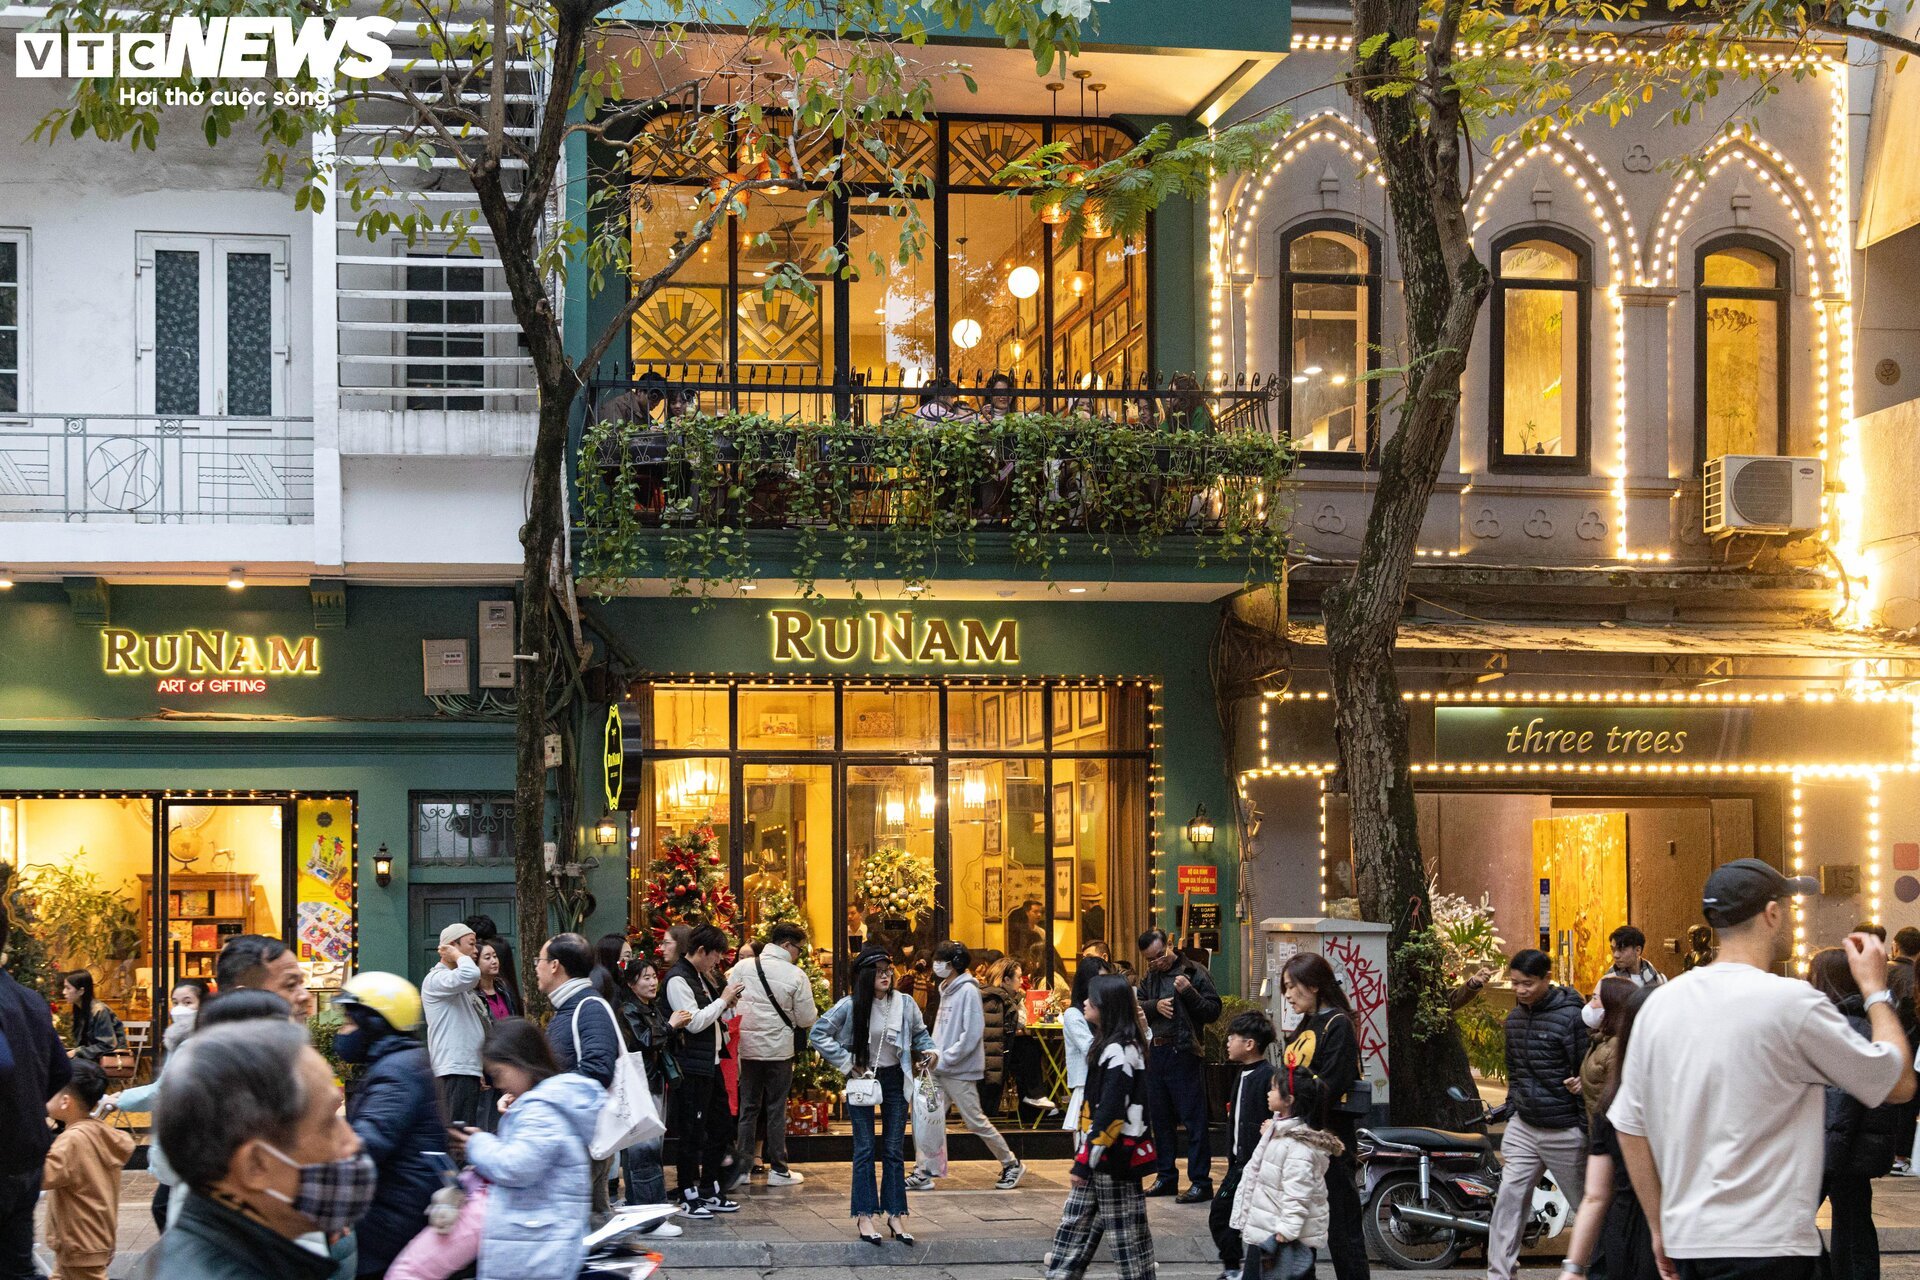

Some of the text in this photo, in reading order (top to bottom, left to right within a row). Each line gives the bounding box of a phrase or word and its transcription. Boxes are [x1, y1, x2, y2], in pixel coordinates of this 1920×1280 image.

[158, 679, 267, 693] ART of GIFTING
[1506, 717, 1688, 754] three trees
